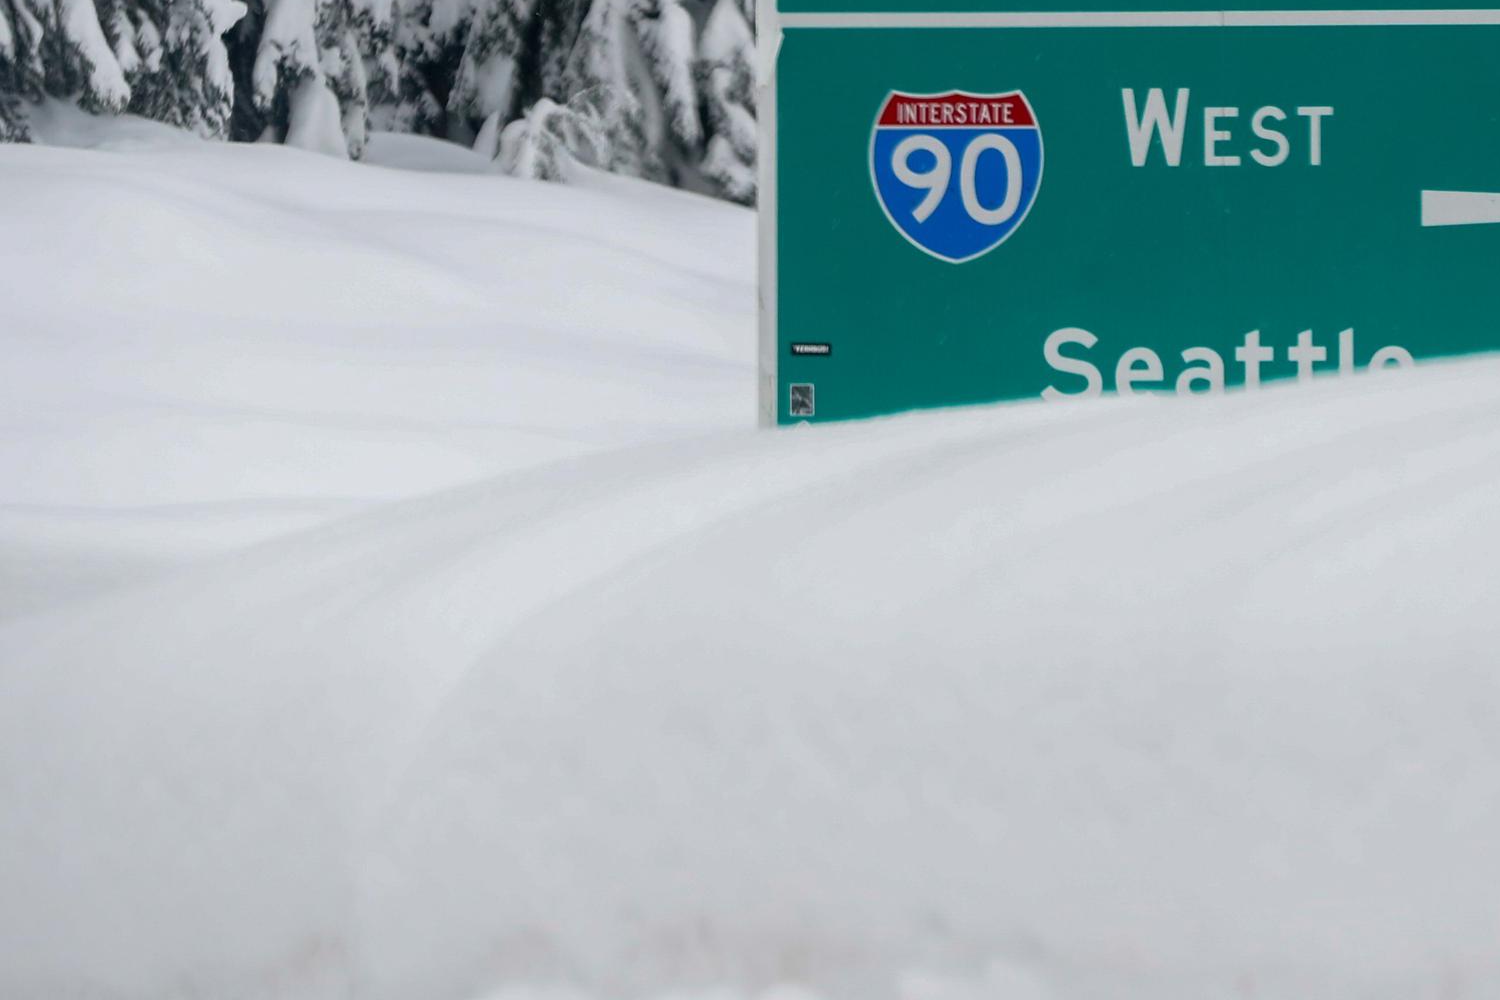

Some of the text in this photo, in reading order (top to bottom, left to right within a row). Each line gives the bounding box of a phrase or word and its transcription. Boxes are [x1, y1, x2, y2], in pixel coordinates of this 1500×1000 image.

[896, 102, 1015, 124] INTERSTATE
[1121, 86, 1335, 167] WEST
[891, 132, 1023, 226] 90
